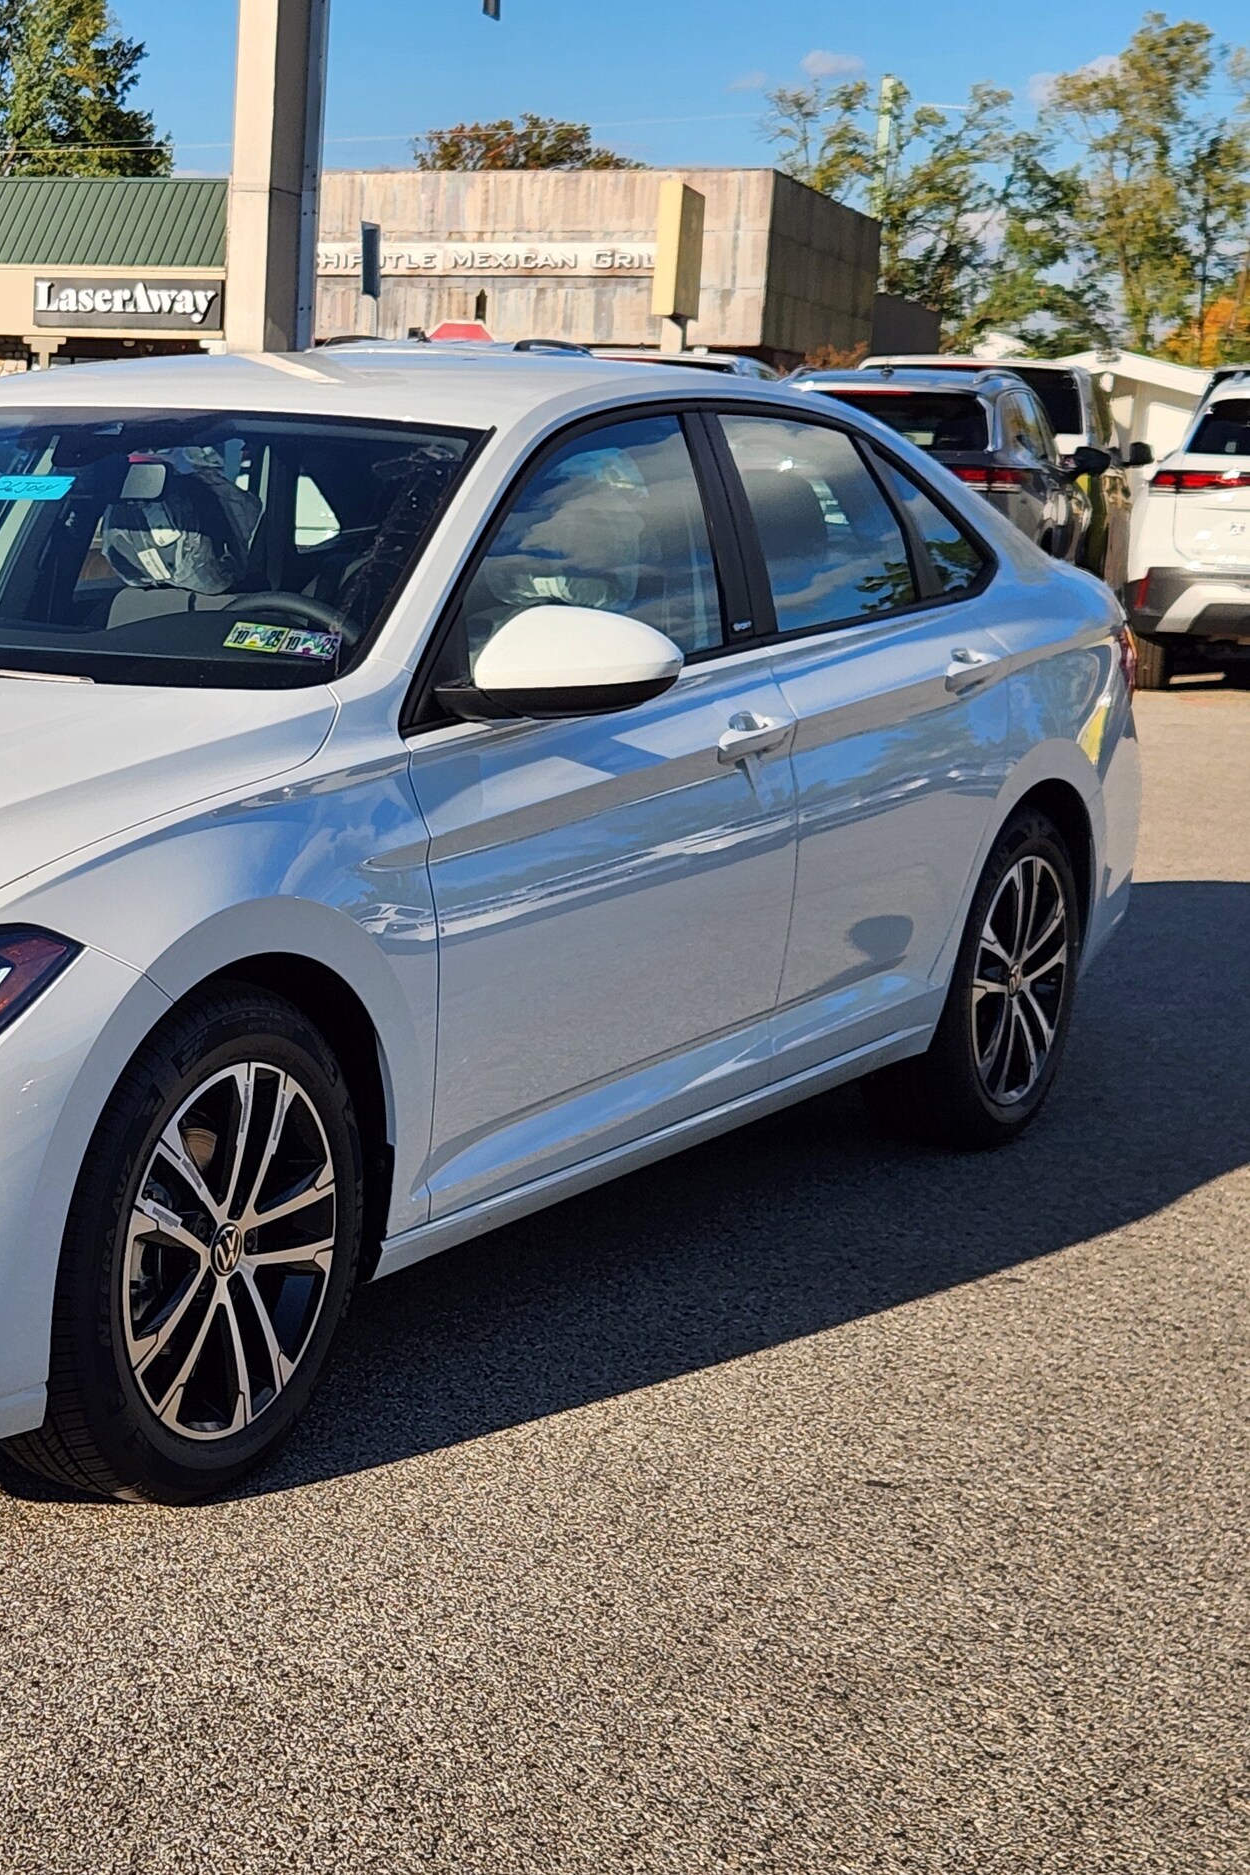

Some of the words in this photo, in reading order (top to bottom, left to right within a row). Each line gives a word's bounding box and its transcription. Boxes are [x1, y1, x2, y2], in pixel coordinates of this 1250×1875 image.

[317, 252, 437, 270] HIPTLE
[591, 251, 656, 270] GRIL
[35, 281, 217, 324] LaserAway
